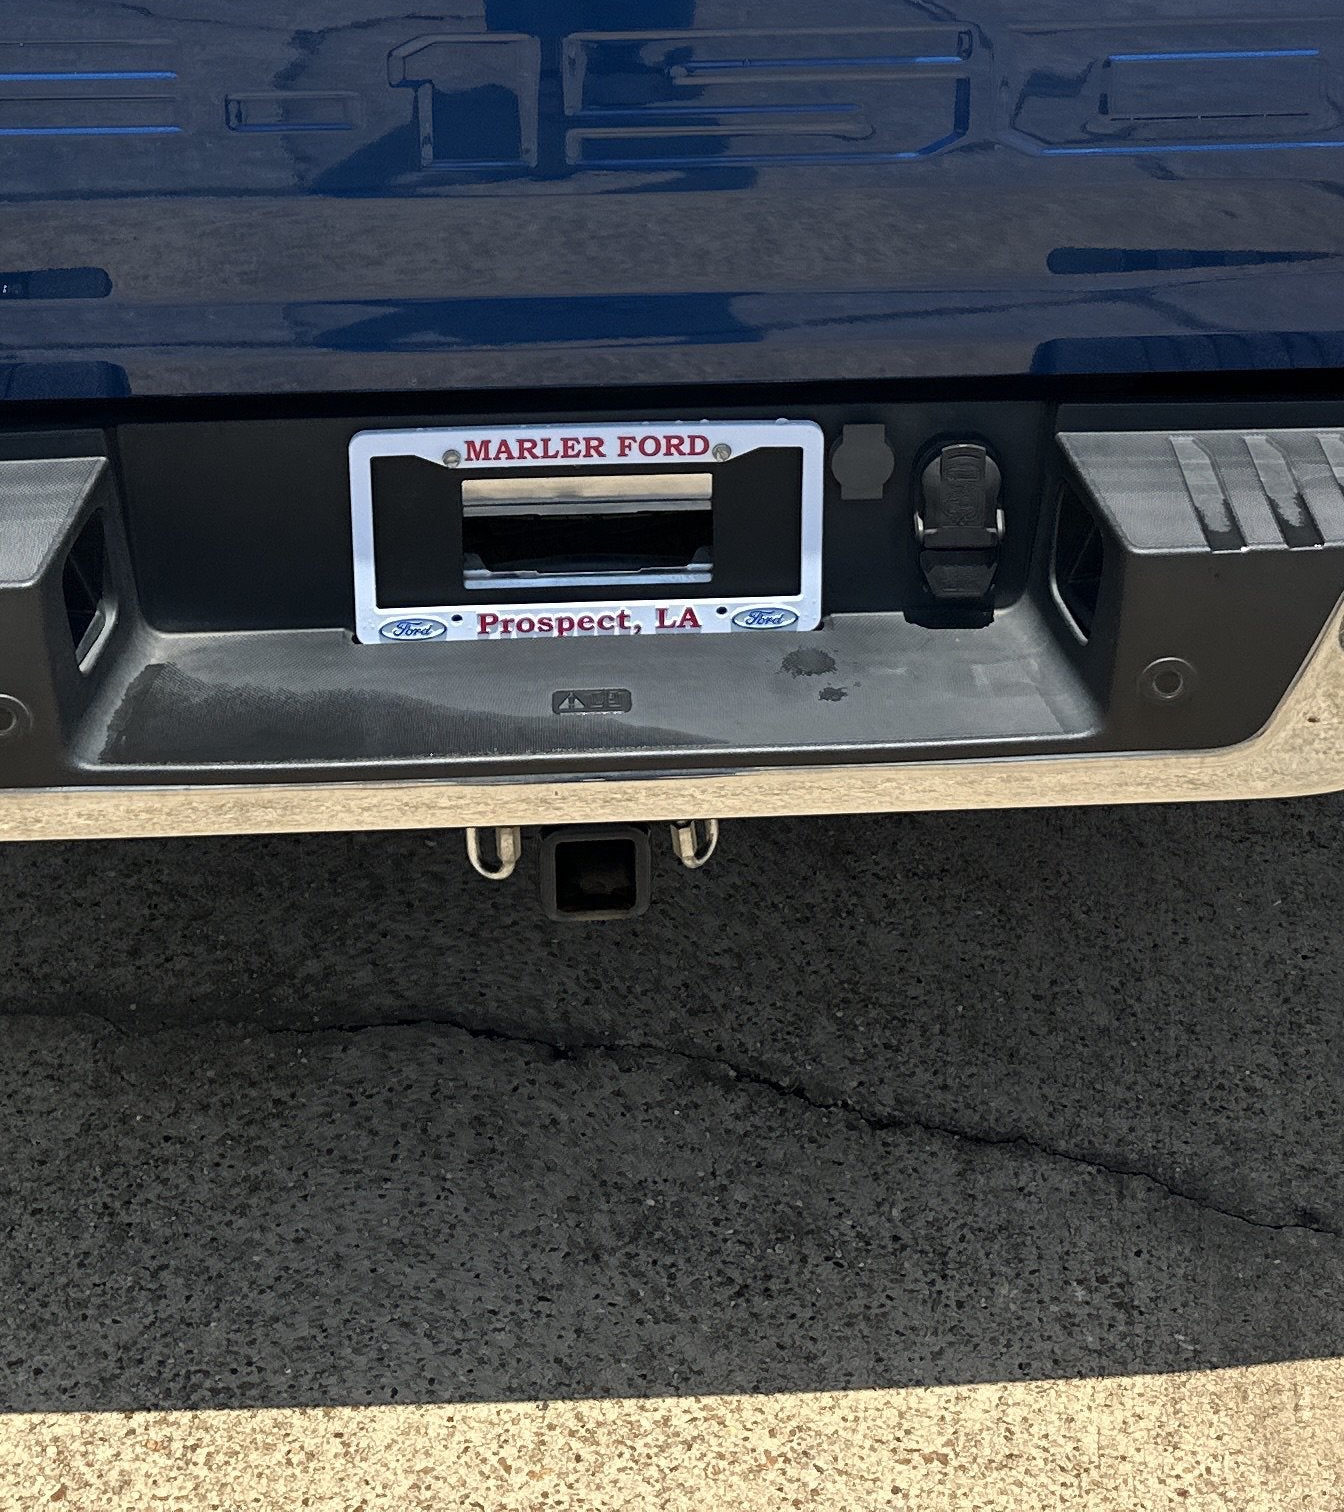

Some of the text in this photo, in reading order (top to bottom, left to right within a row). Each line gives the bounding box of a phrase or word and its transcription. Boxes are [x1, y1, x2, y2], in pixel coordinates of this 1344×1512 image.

[463, 433, 710, 462] MARLER FORD
[392, 620, 432, 637] Ford
[477, 607, 703, 637] Prospect, LA
[744, 609, 785, 626] Ford
